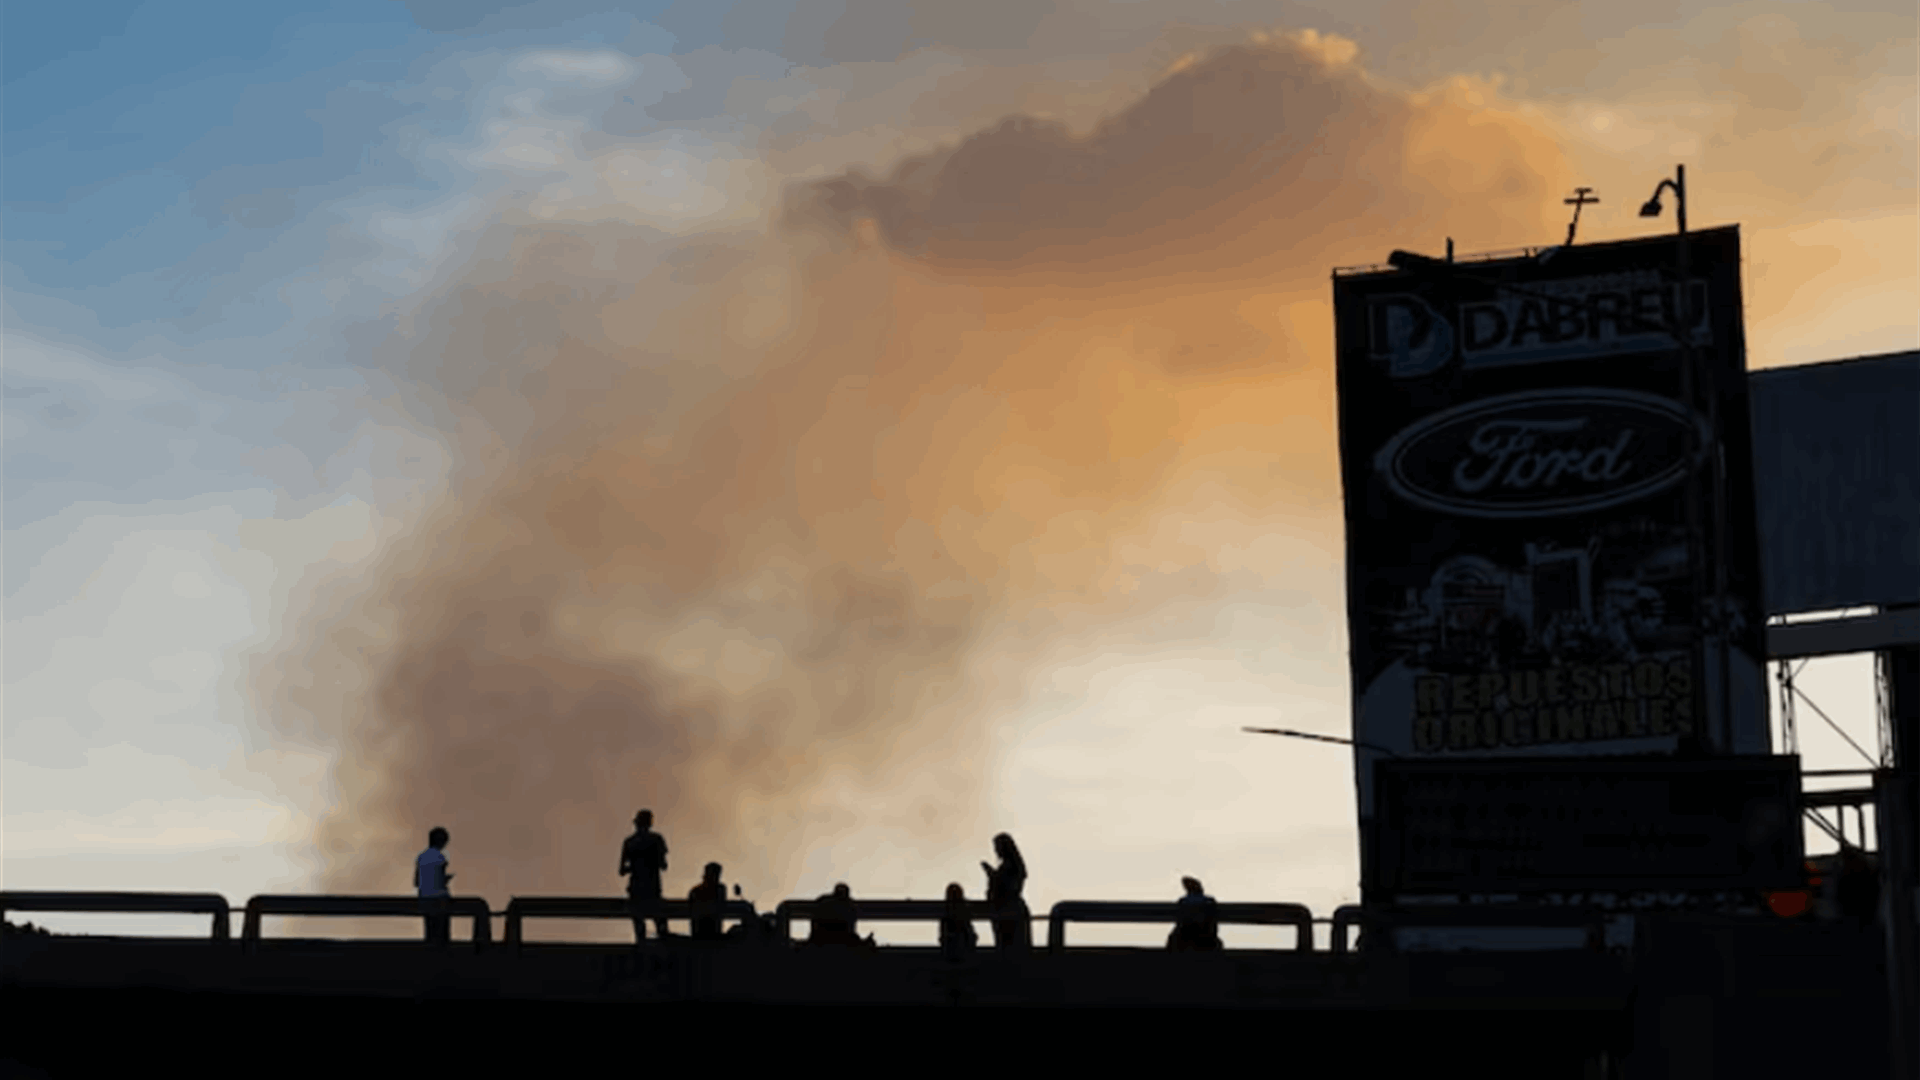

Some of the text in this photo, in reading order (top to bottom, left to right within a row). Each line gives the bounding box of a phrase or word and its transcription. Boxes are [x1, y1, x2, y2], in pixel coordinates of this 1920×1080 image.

[1460, 279, 1712, 360] DABREU
[1453, 416, 1636, 493] Ford
[1415, 660, 1693, 713] REPUESTOS
[1414, 699, 1693, 749] ORIGINALES
